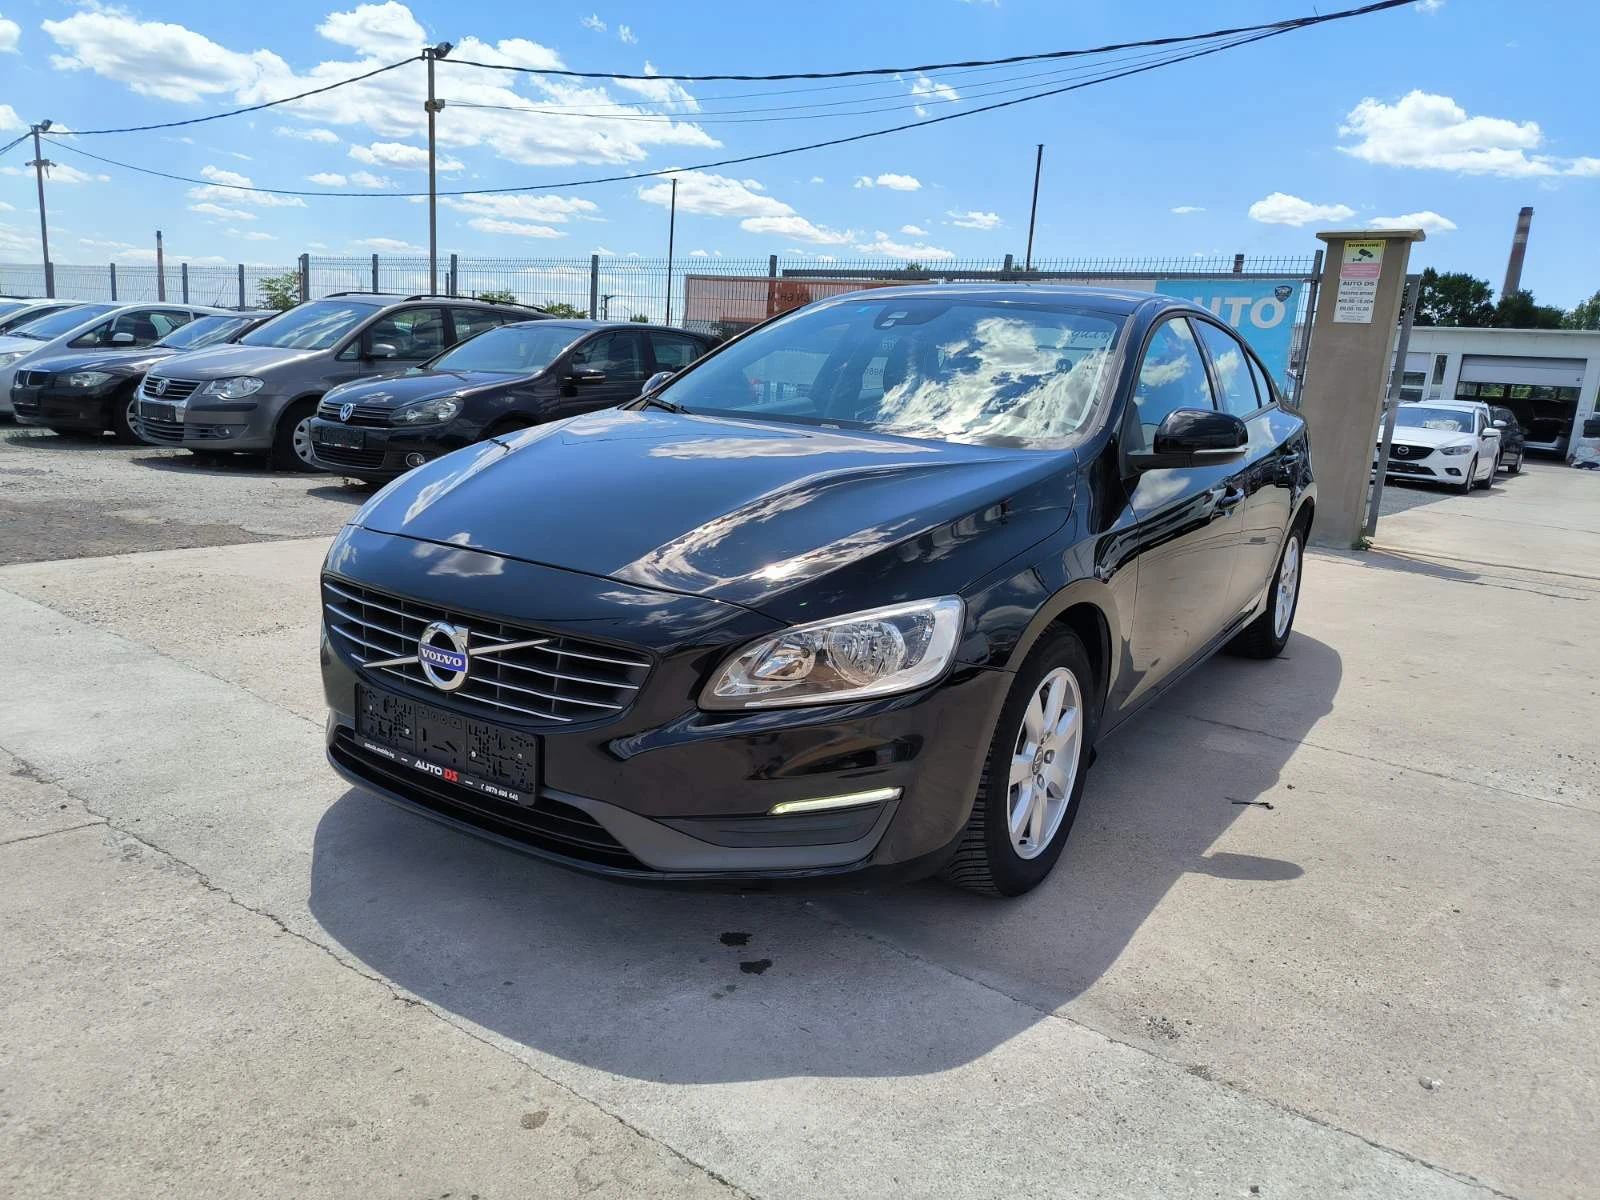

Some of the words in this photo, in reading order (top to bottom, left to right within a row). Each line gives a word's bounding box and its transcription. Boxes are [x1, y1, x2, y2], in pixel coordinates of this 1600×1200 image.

[421, 647, 463, 668] VOLVO
[414, 759, 442, 776] AUTO
[444, 767, 459, 783] DS
